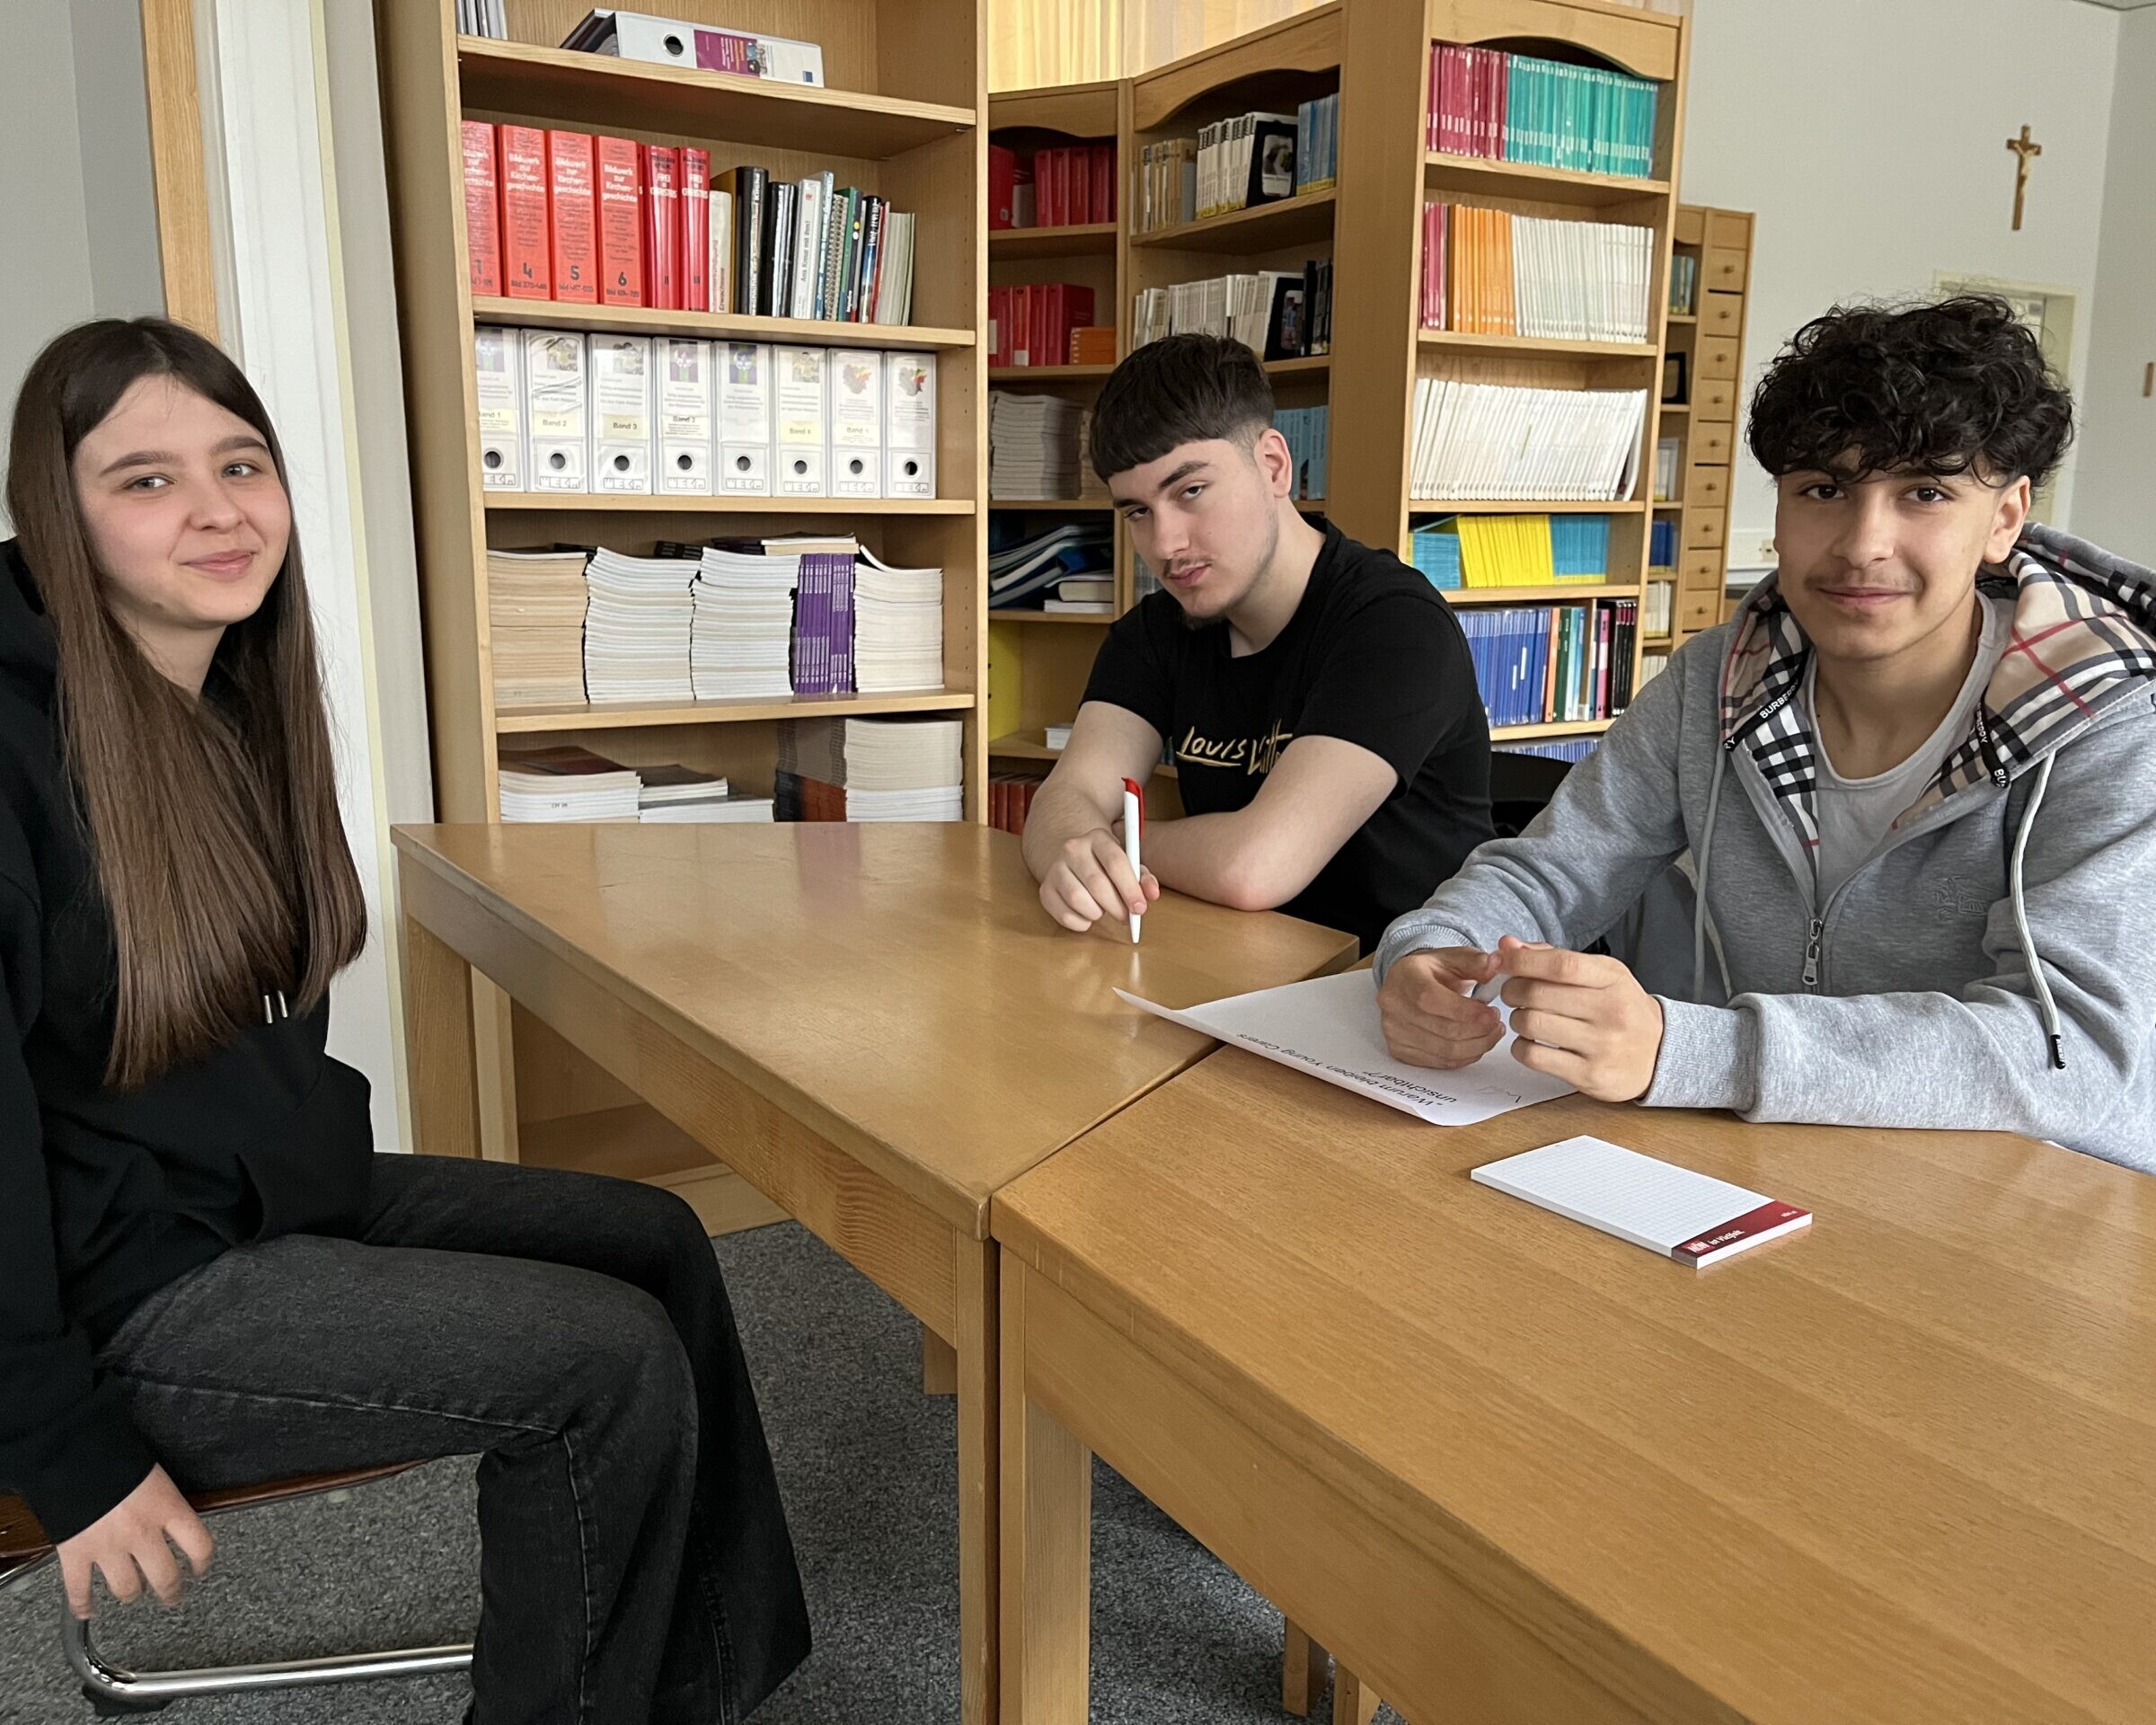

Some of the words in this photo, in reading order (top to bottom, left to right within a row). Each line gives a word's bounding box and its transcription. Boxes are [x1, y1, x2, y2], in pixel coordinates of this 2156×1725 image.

[570, 265, 580, 280] 5
[618, 271, 627, 287] 6
[543, 419, 561, 427] Band
[1236, 1033, 1280, 1050] Carers
[1280, 1048, 1323, 1066] Young
